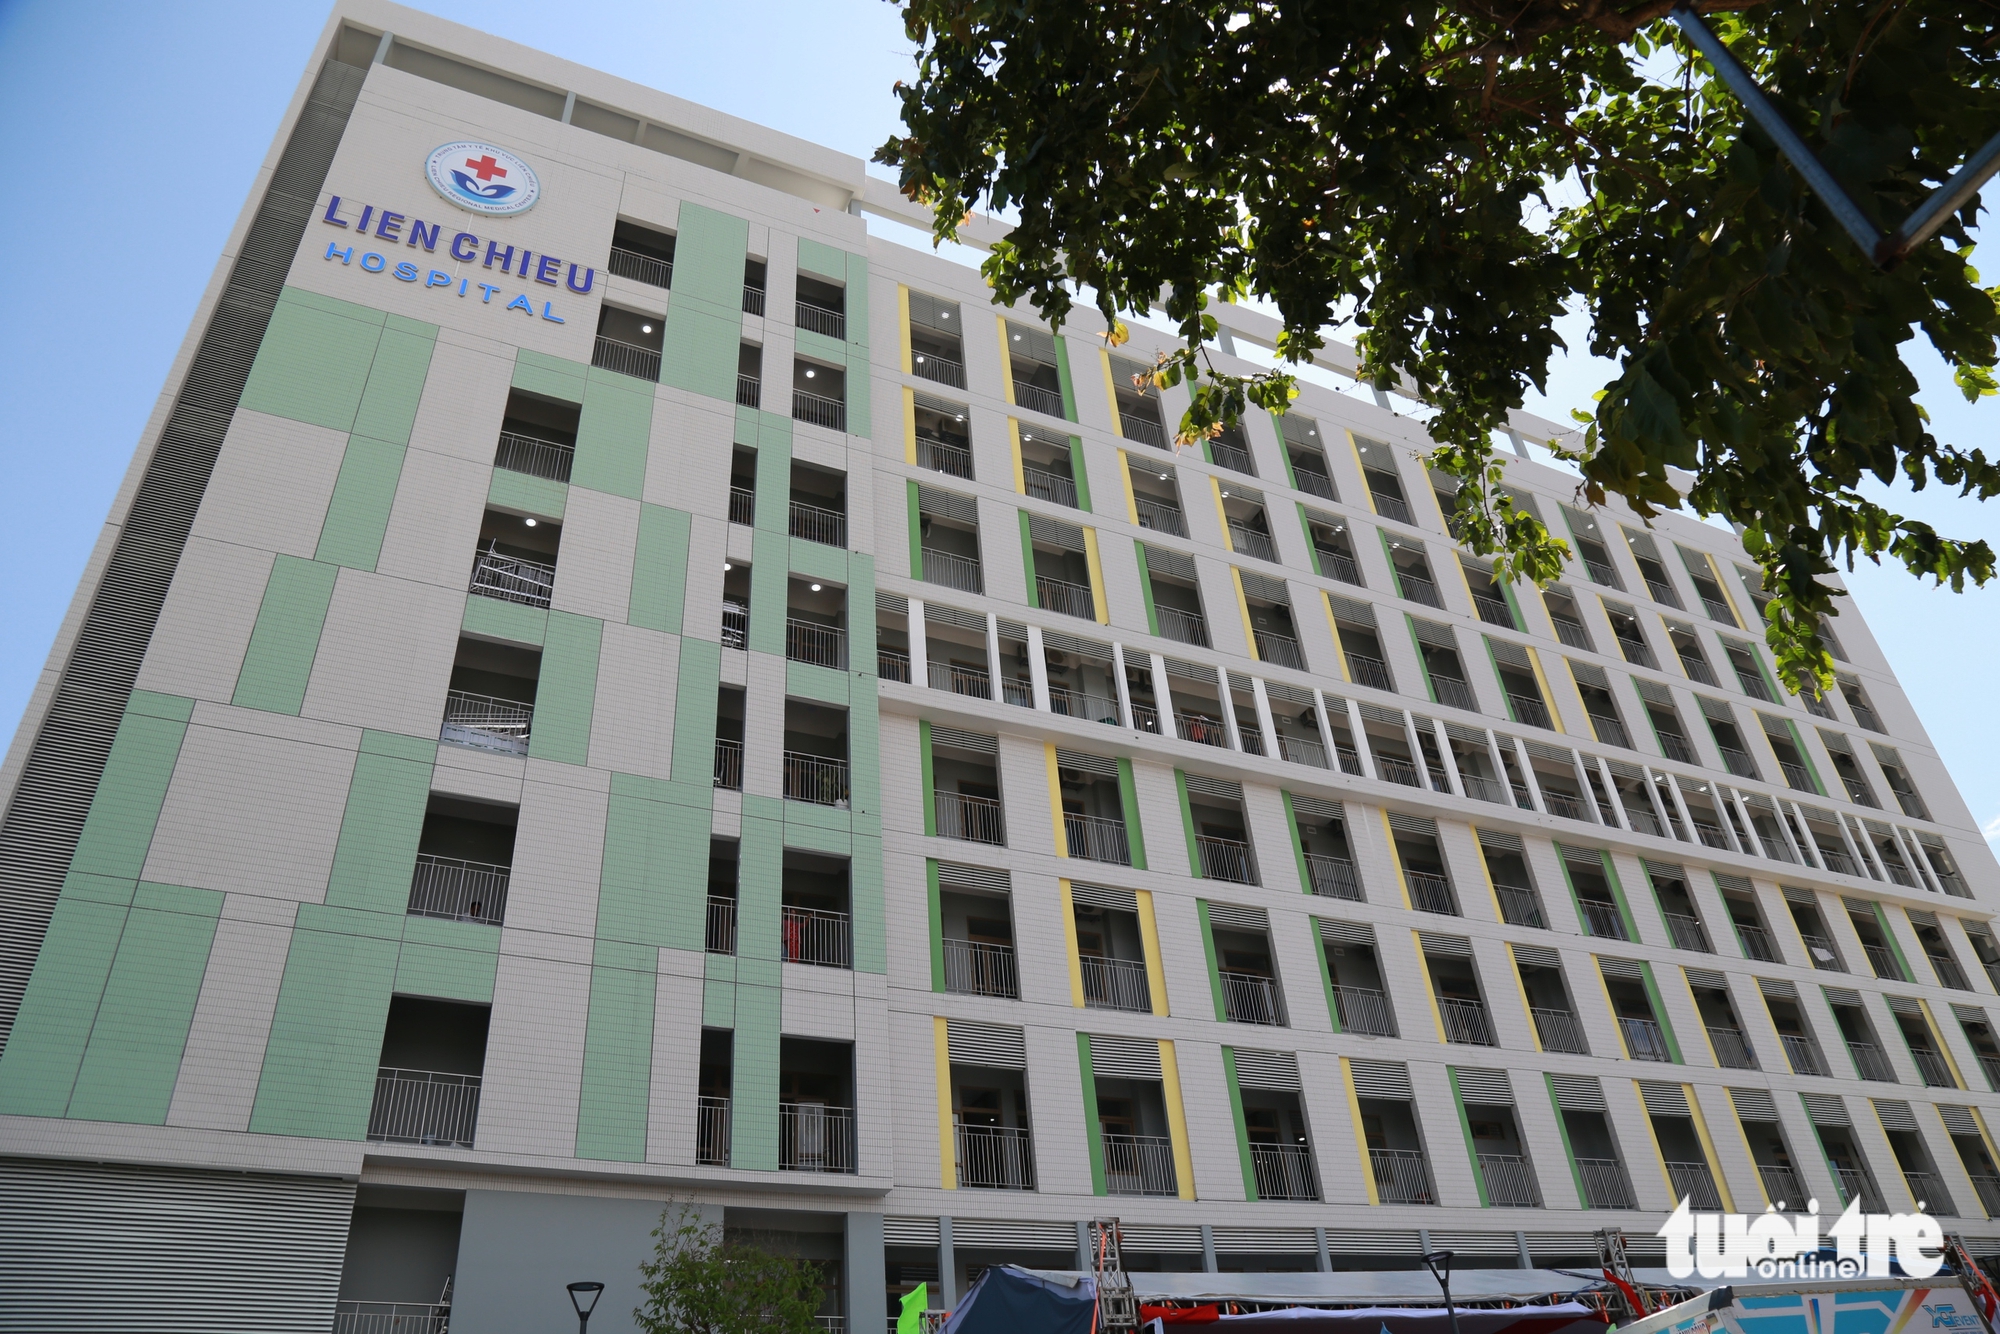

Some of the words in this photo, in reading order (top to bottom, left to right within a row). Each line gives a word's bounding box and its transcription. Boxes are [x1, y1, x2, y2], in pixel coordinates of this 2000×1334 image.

[448, 190, 482, 209] REGIONAL
[514, 194, 532, 208] CENTER
[322, 195, 441, 253] LIEN
[449, 232, 595, 294] CHIEU
[323, 242, 565, 324] HOSPITAL
[1953, 1315, 1980, 1327] EVENT
